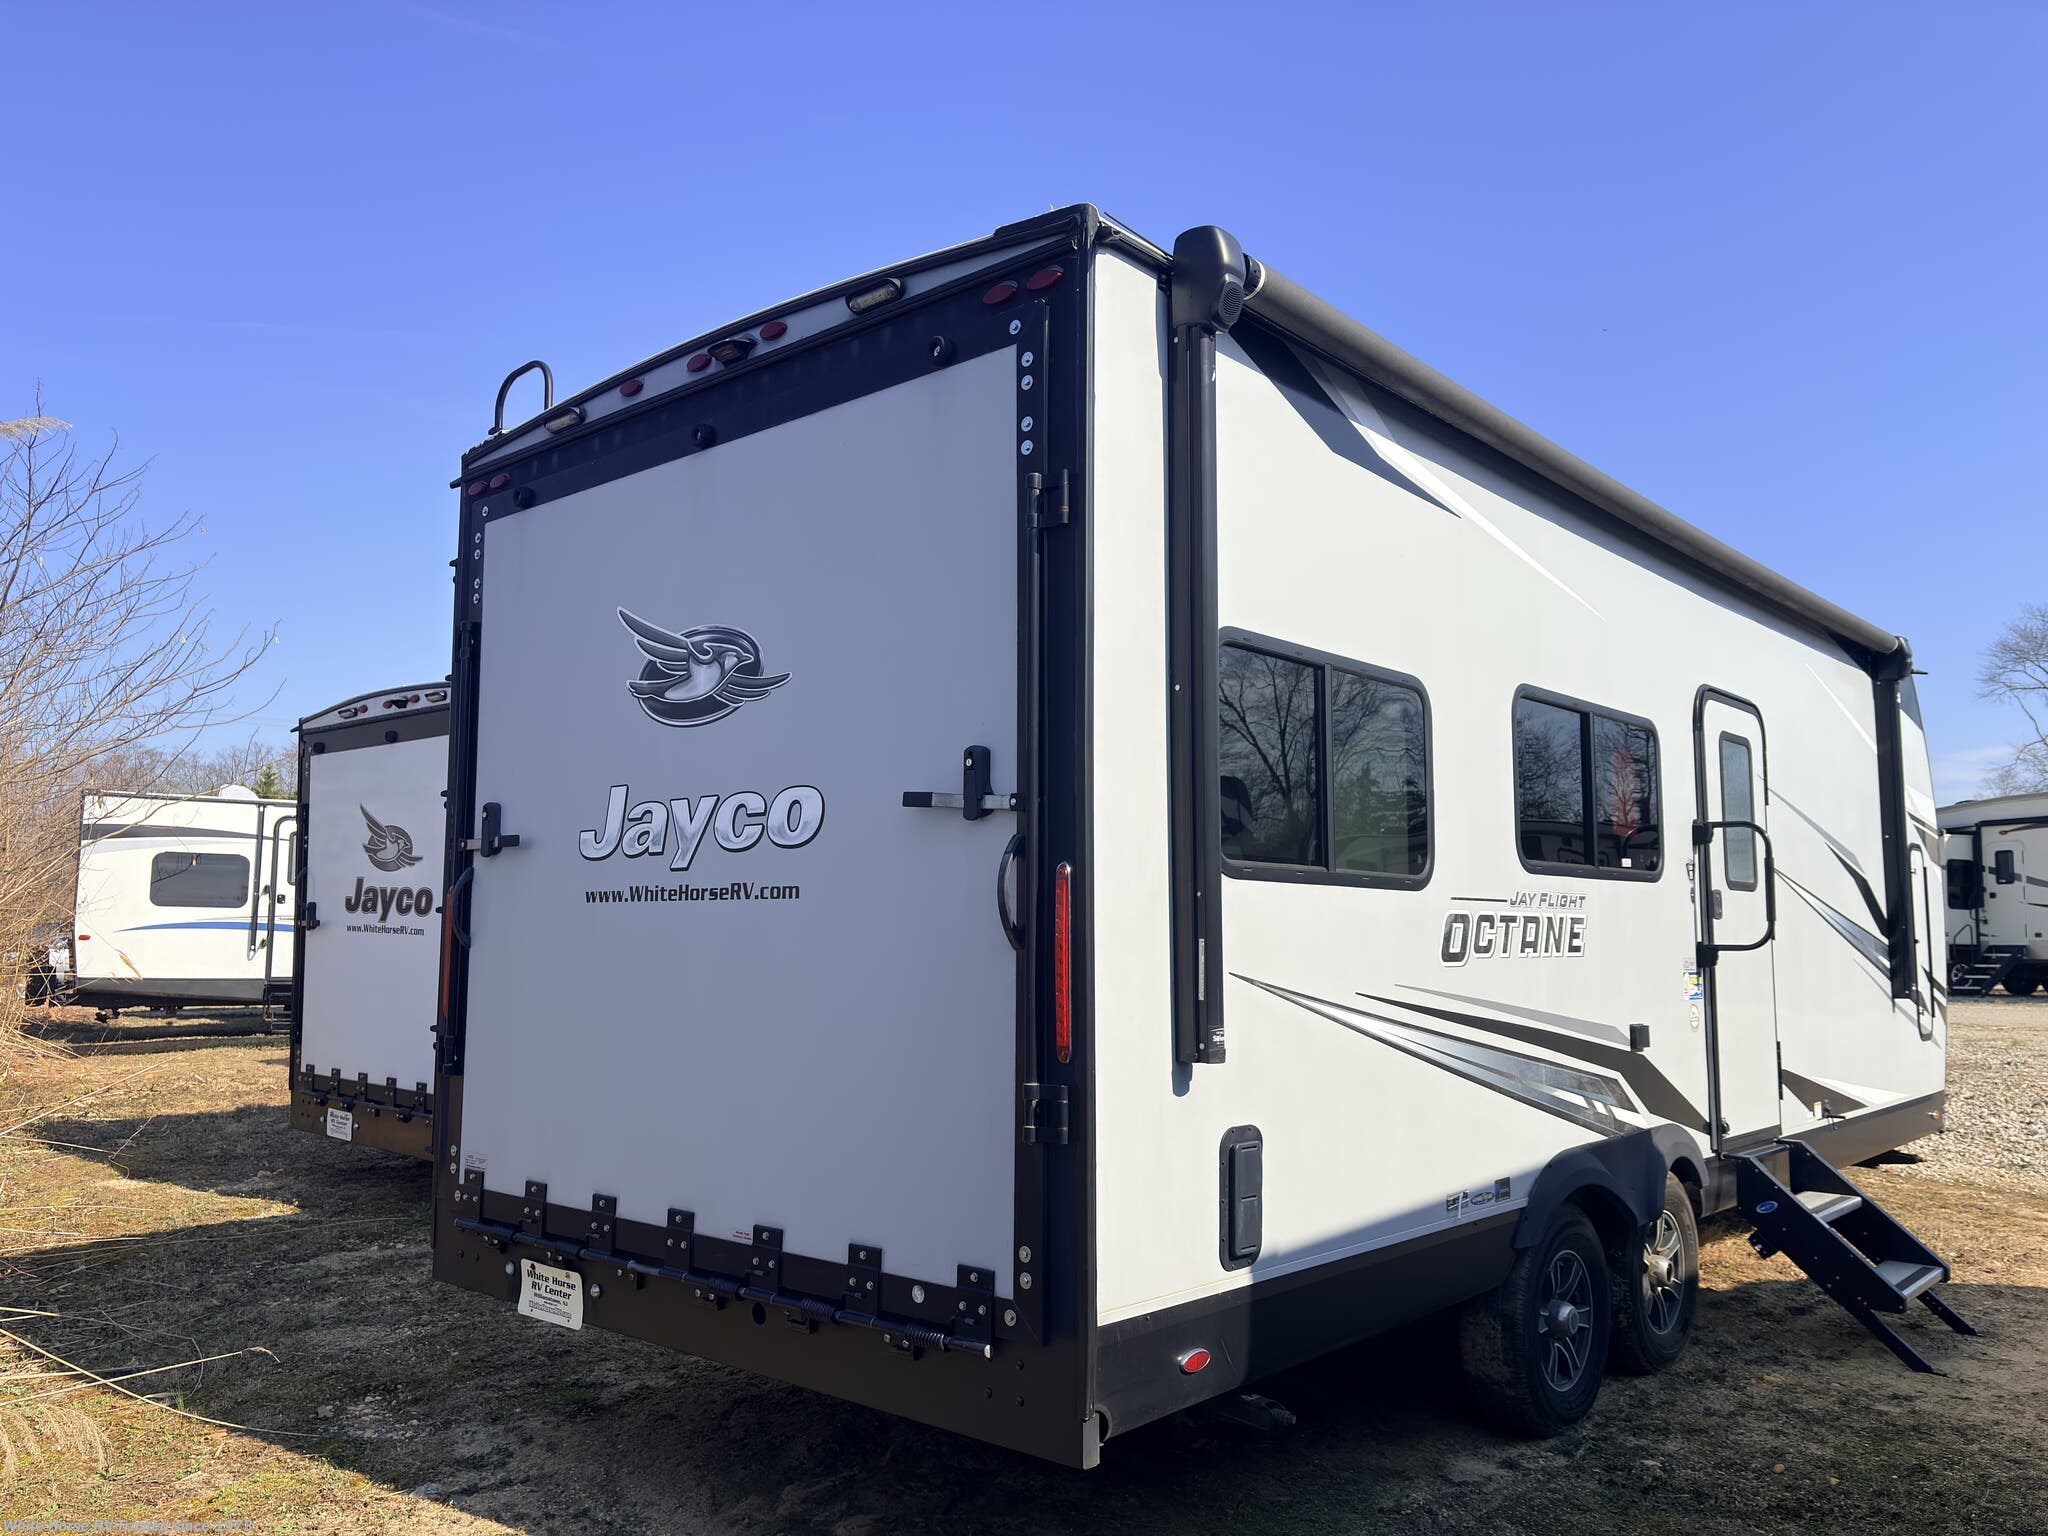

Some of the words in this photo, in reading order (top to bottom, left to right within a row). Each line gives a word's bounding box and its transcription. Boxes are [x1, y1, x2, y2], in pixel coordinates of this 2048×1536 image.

[579, 784, 826, 872] Jayco
[345, 876, 433, 923] Jayco
[585, 882, 800, 903] www.WhiteHorseRV.com
[1509, 891, 1536, 906] JAY
[1538, 892, 1587, 908] FLIGHT
[346, 924, 425, 936] www.WhiteHorseRV.com
[1440, 912, 1587, 965] OCTANE
[526, 1269, 550, 1283] White
[552, 1276, 577, 1291] Horse
[531, 1281, 543, 1292] RV
[544, 1284, 572, 1300] Center
